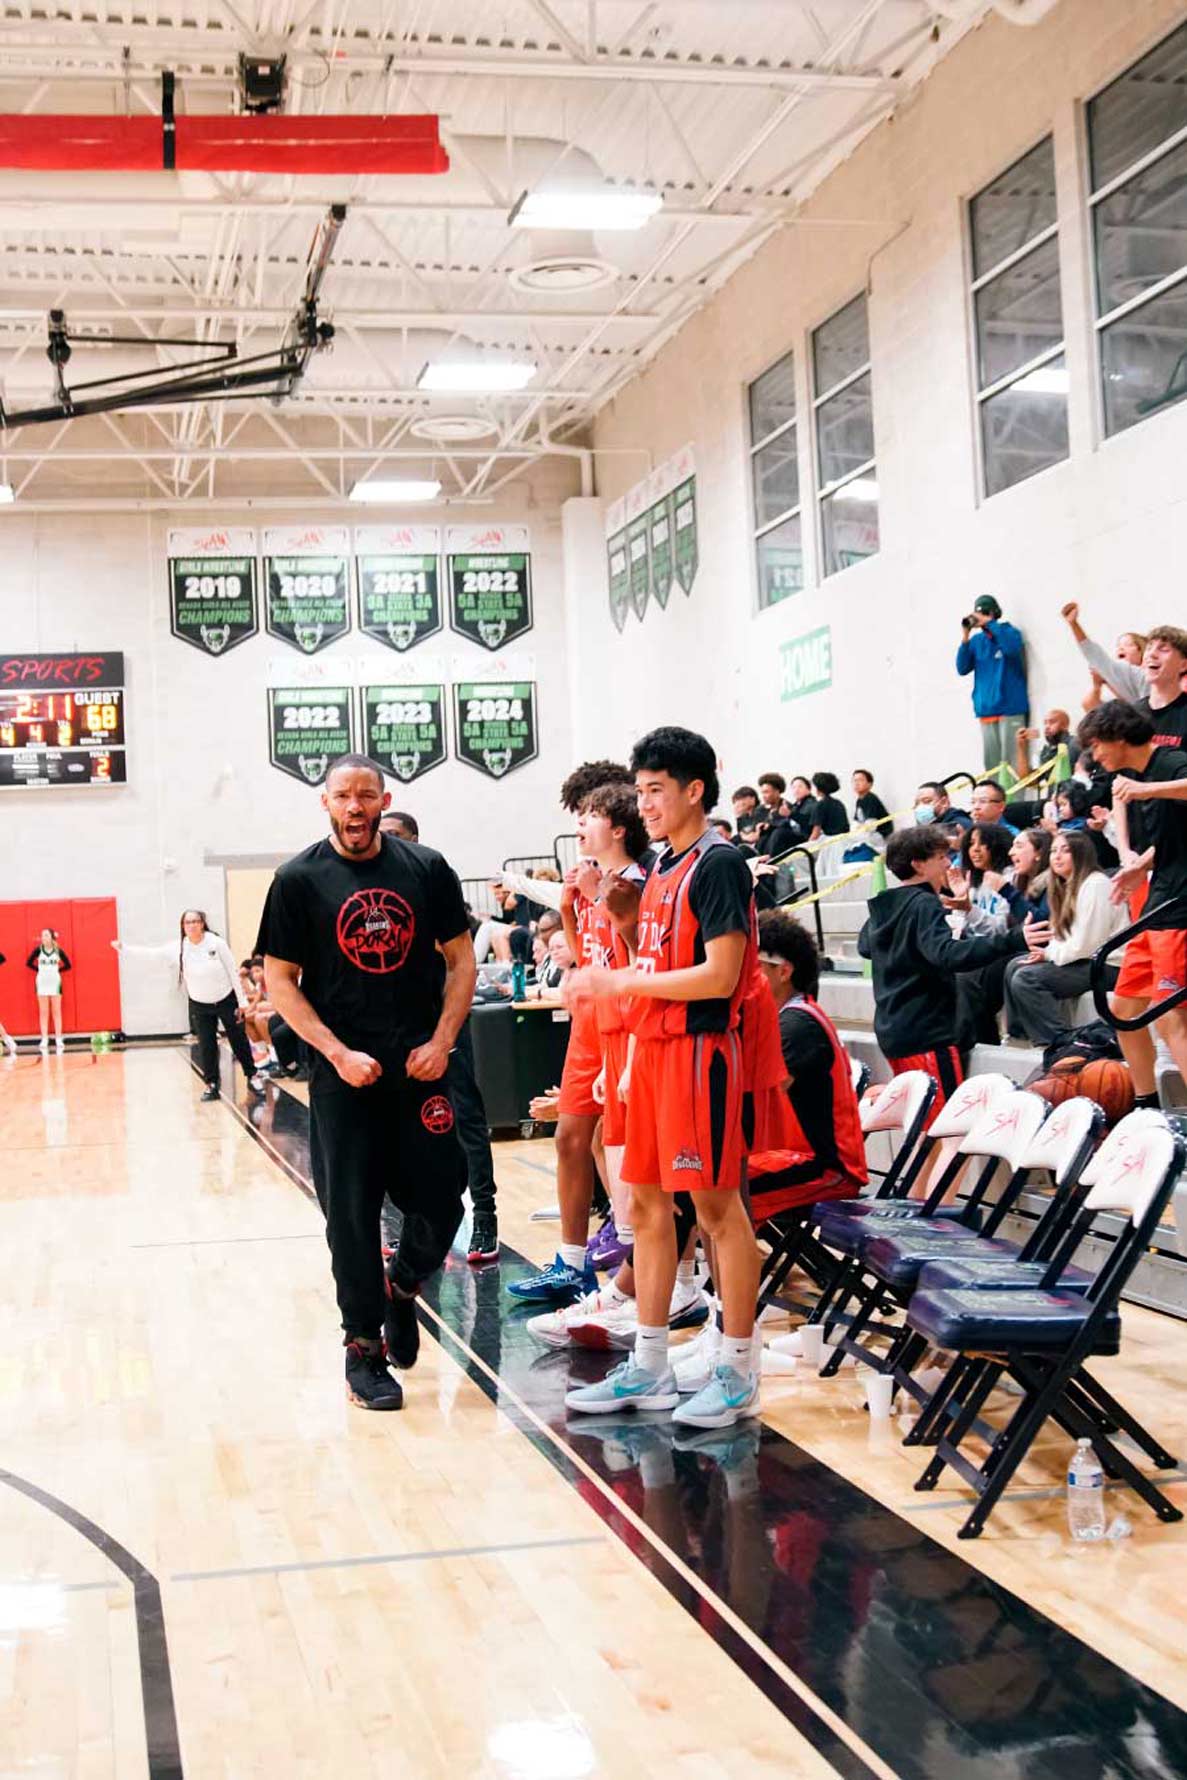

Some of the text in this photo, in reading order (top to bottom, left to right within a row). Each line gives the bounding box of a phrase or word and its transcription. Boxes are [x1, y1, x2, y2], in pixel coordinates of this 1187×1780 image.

[185, 576, 242, 599] 2019
[280, 576, 337, 598] 2020
[373, 571, 427, 594] 2021
[463, 571, 519, 593] 2022
[179, 609, 251, 625] CHAMPIONS
[272, 609, 344, 624] CHAMPIONS
[372, 609, 429, 622] CHAMPIONS
[463, 609, 520, 622] CHAMPIONS
[2, 657, 105, 683] SPORTS
[780, 634, 832, 692] HOME
[74, 691, 120, 706] GUEST
[87, 704, 118, 731] 68
[283, 706, 341, 728] 2022
[376, 702, 432, 724] 2023
[467, 699, 524, 721] 2024
[277, 739, 349, 755] CHAMPIONS
[377, 740, 433, 752] CHAMPIONS
[469, 737, 525, 749] CHAMPIONS
[97, 757, 110, 777] 2
